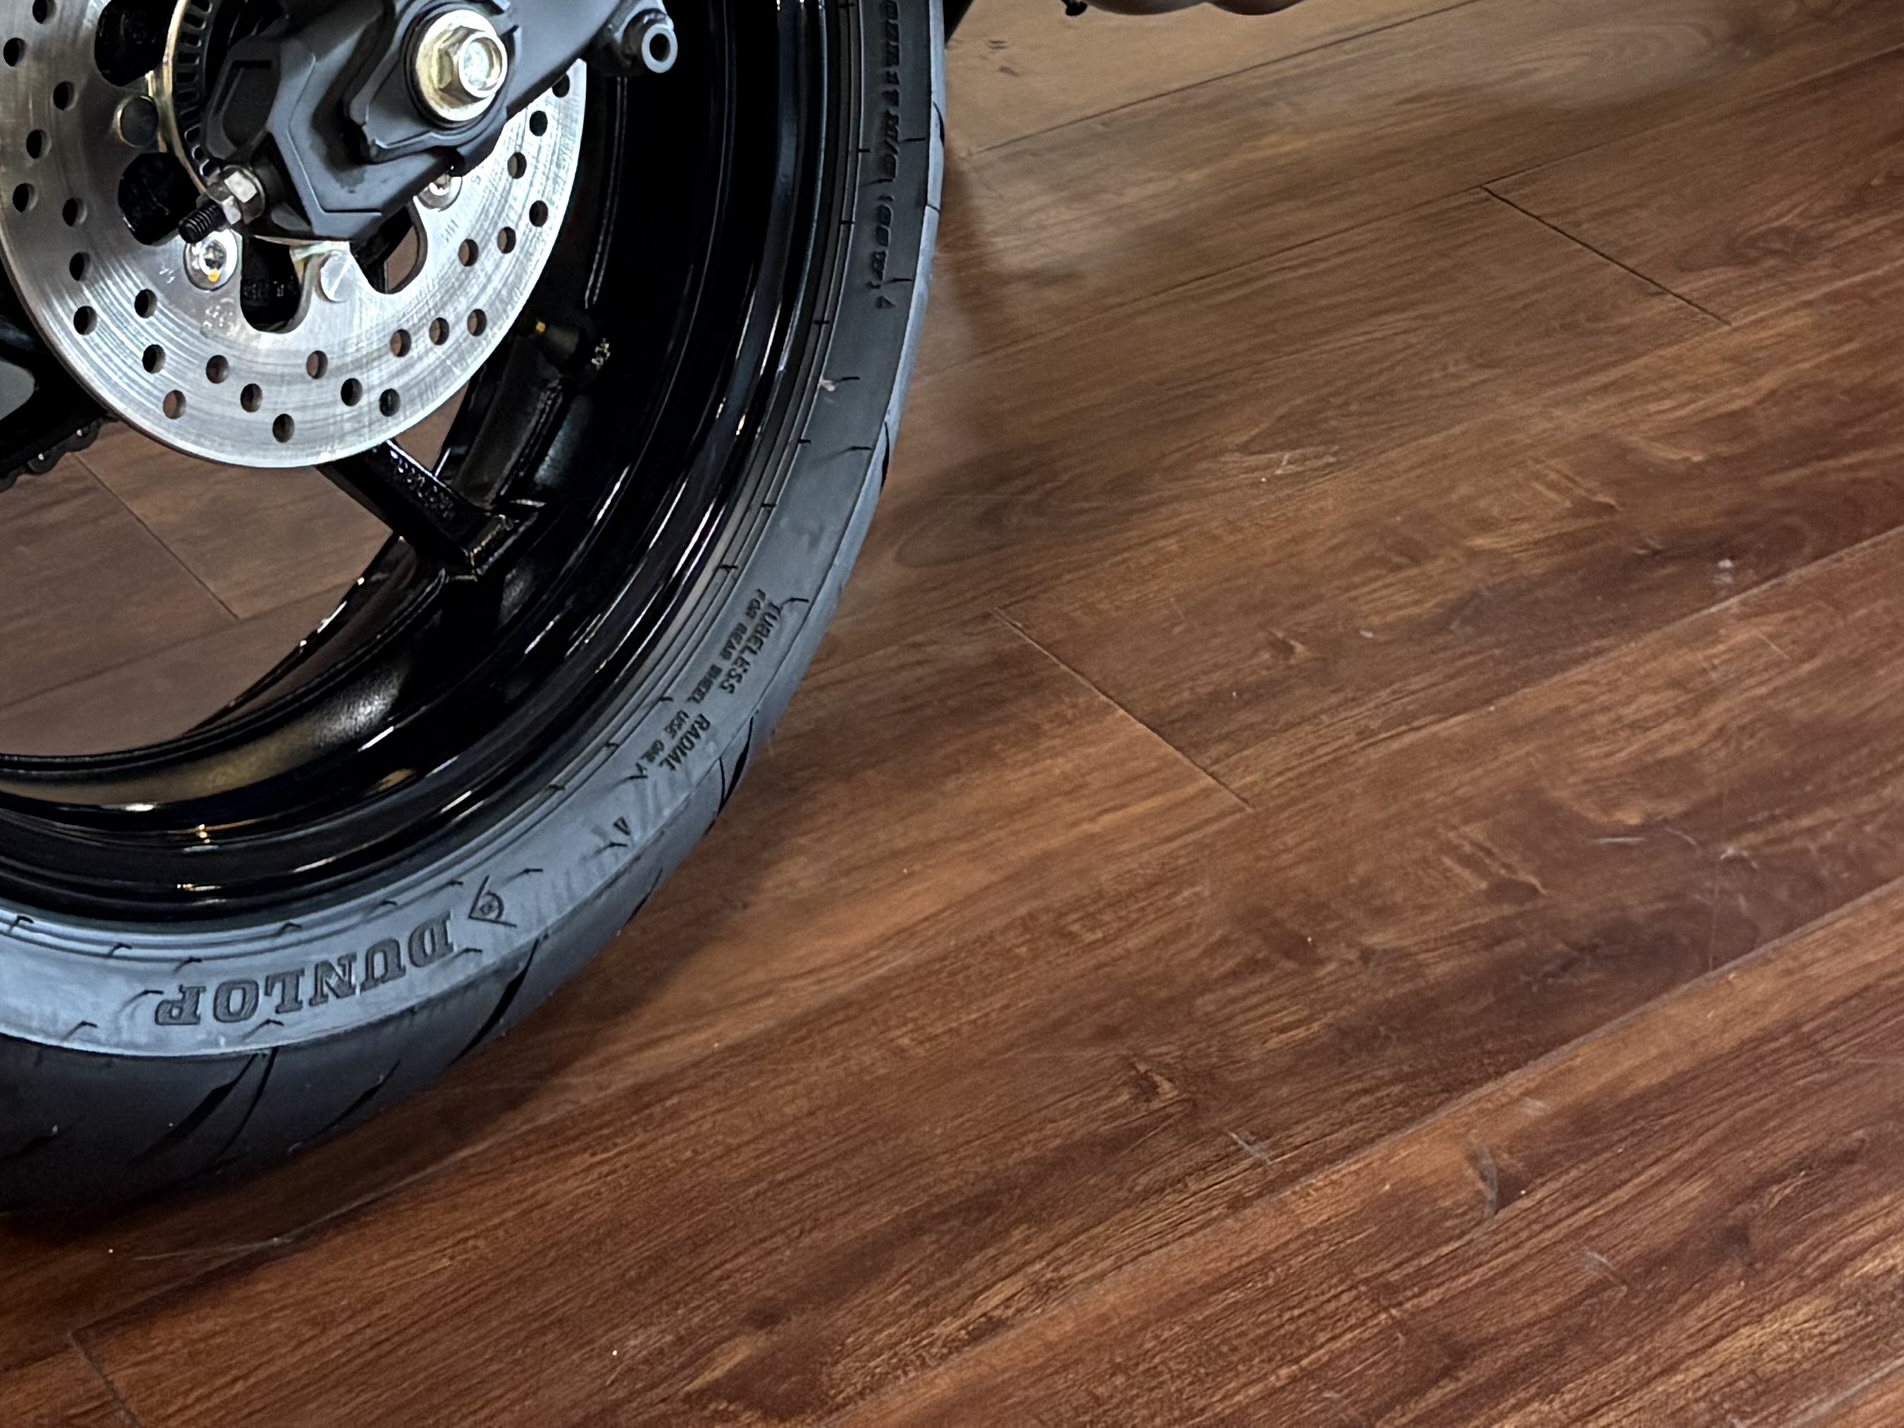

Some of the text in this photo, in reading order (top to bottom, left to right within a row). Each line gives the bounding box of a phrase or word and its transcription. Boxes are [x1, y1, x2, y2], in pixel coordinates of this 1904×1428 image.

[745, 588, 767, 620] FOR
[719, 622, 748, 661] REAR
[657, 601, 784, 771] TUBELESS RADIAL
[663, 709, 690, 739] USE
[154, 910, 457, 1026] DUNLOP
